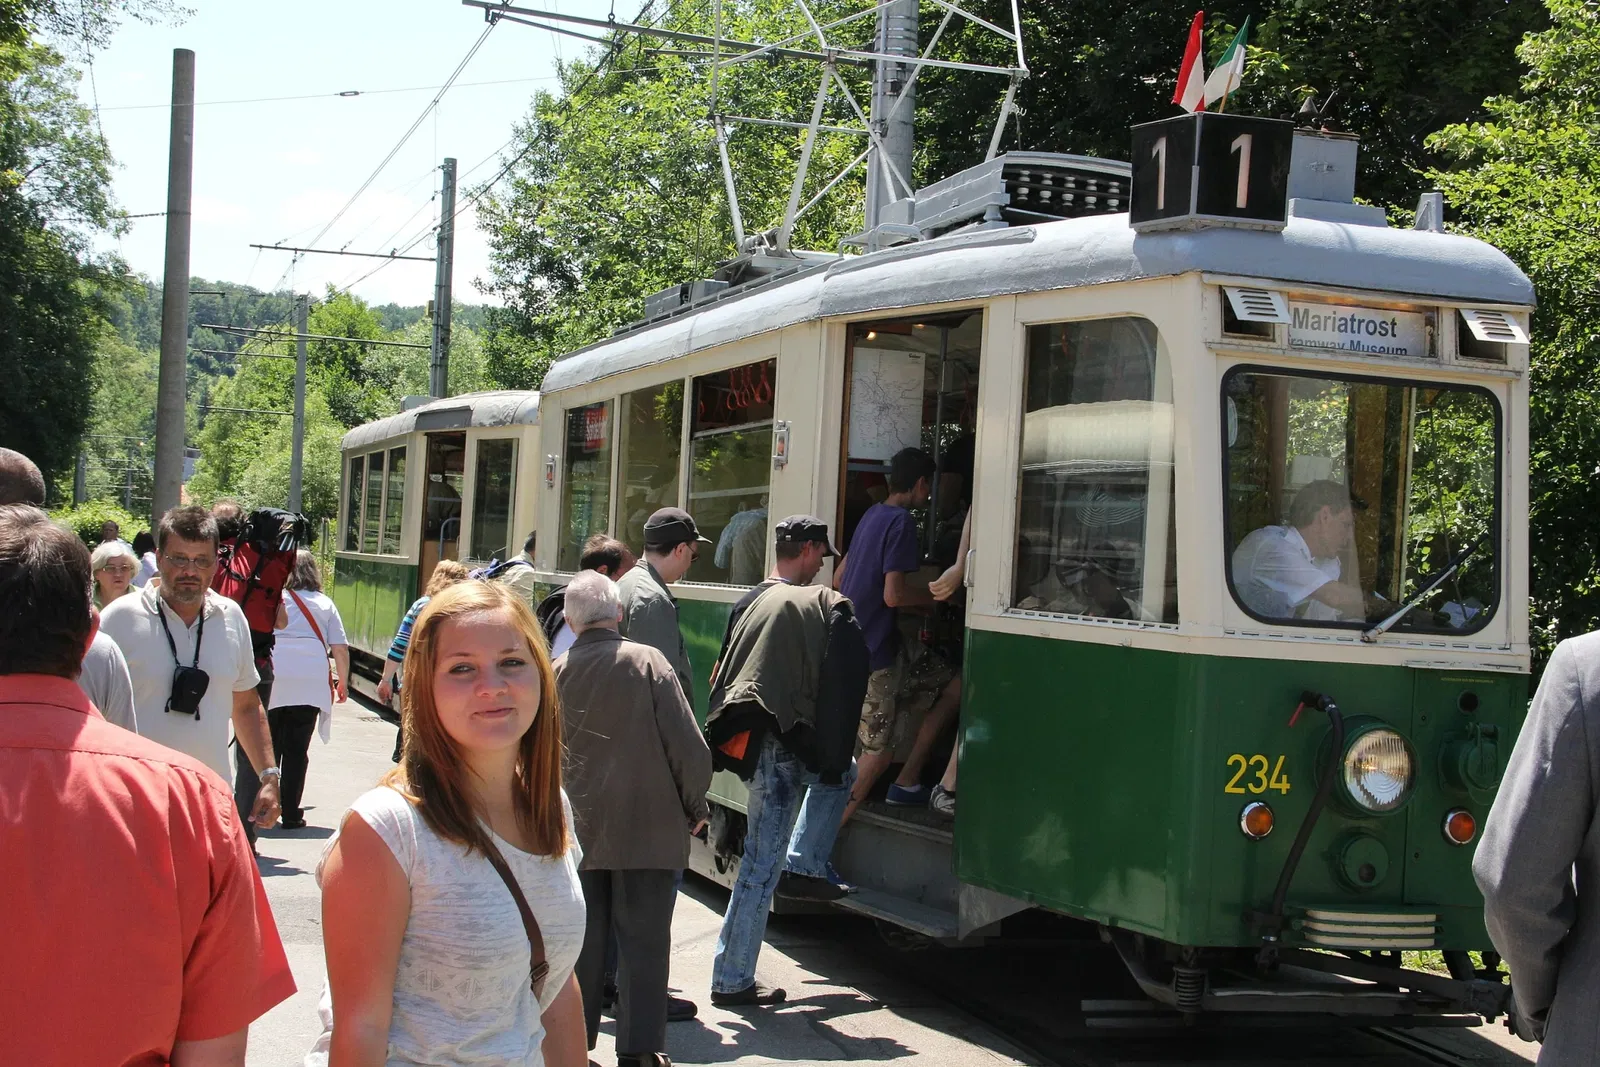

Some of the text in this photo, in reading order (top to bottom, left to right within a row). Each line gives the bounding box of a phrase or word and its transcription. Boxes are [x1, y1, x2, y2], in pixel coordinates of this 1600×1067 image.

[1151, 136, 1167, 210] 1
[1230, 133, 1253, 209] 1
[1292, 307, 1398, 338] Mariatrost
[1289, 337, 1408, 356] ramway Museum
[1224, 753, 1291, 795] 234
